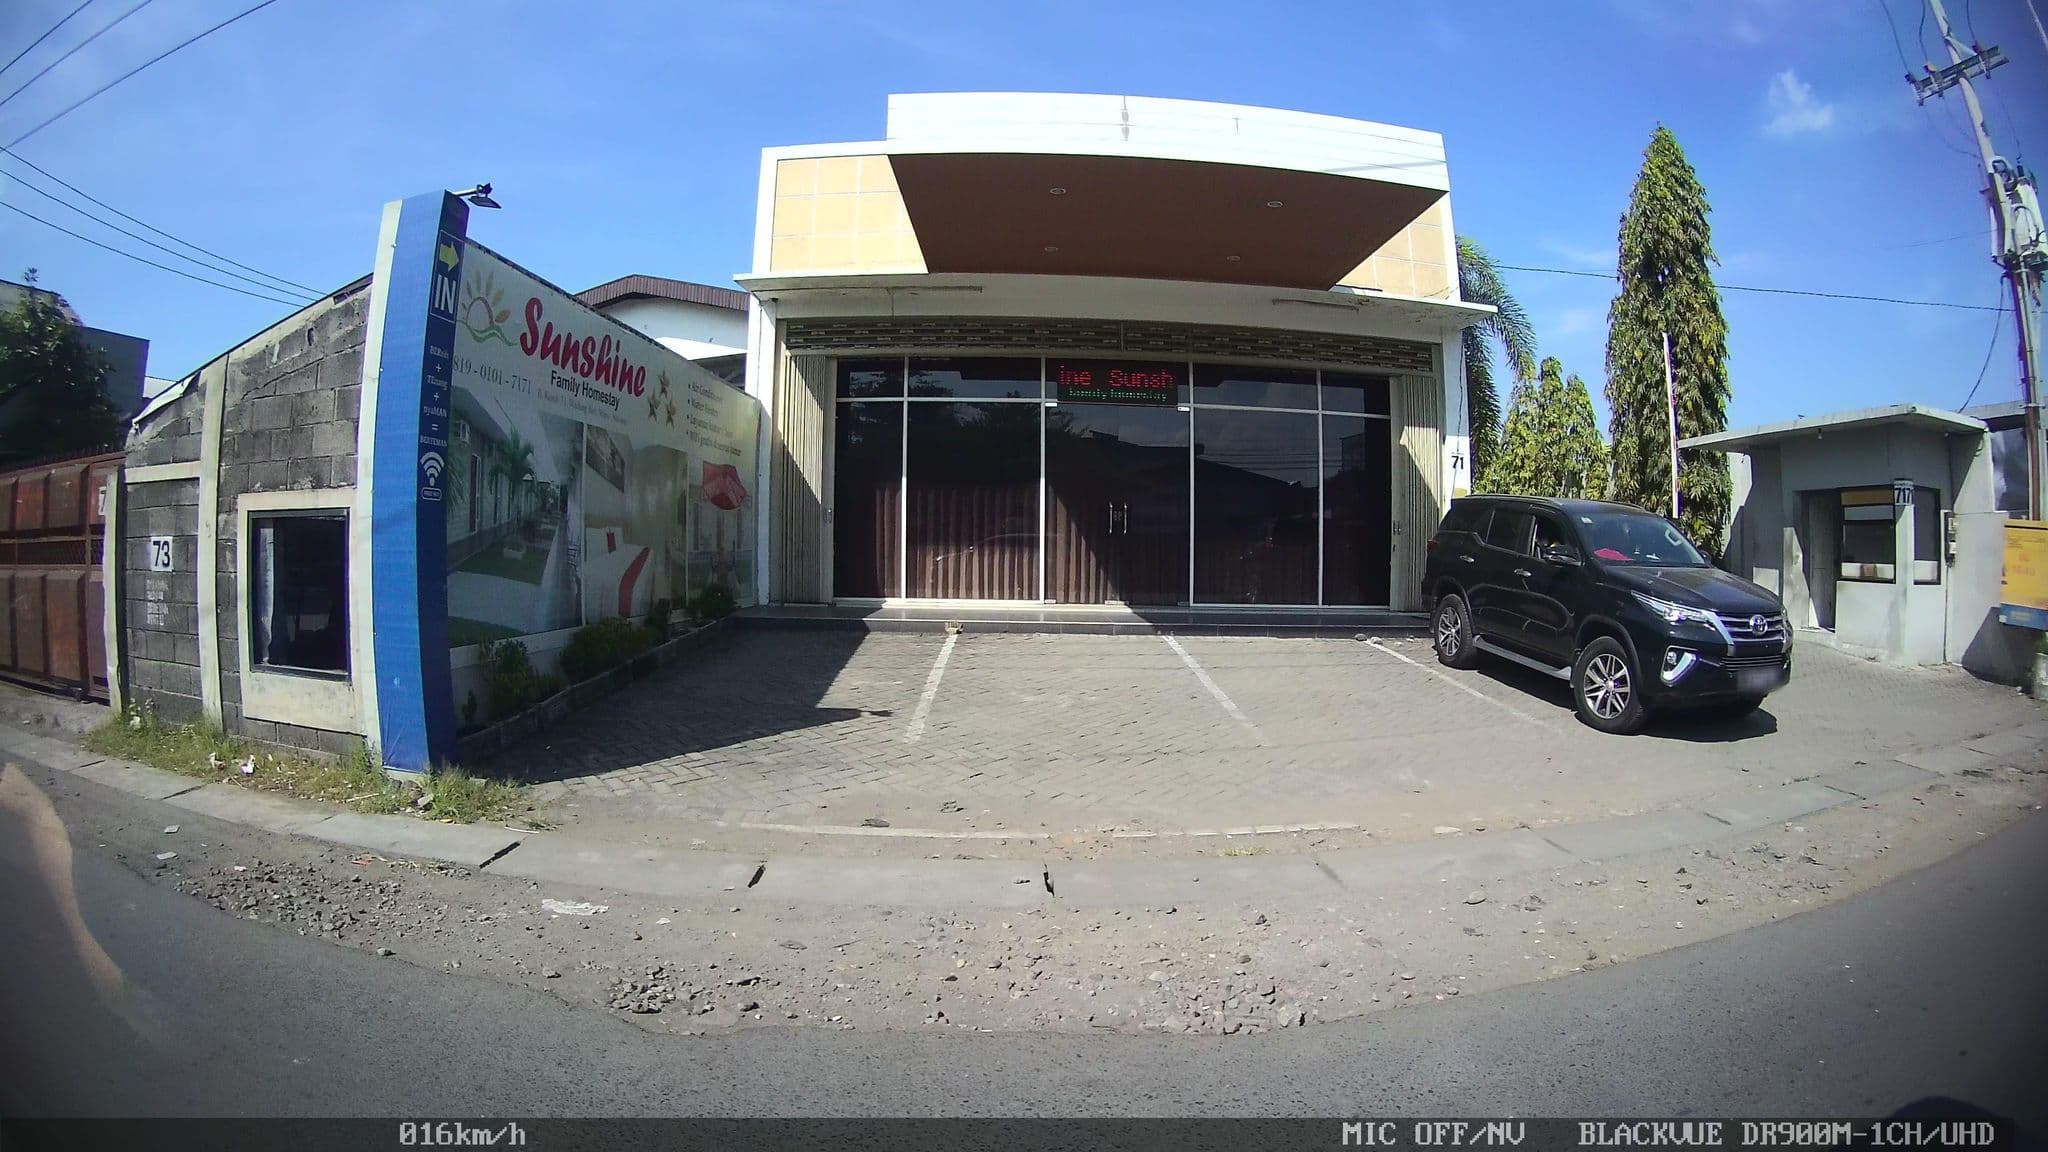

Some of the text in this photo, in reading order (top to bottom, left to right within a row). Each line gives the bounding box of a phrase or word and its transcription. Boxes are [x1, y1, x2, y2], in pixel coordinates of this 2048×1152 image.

[433, 275, 456, 315] IN
[519, 297, 646, 397] Sunshine
[551, 370, 581, 397] Family
[582, 382, 620, 411] Homestay
[1451, 455, 1464, 470] 71
[152, 540, 170, 567] 73
